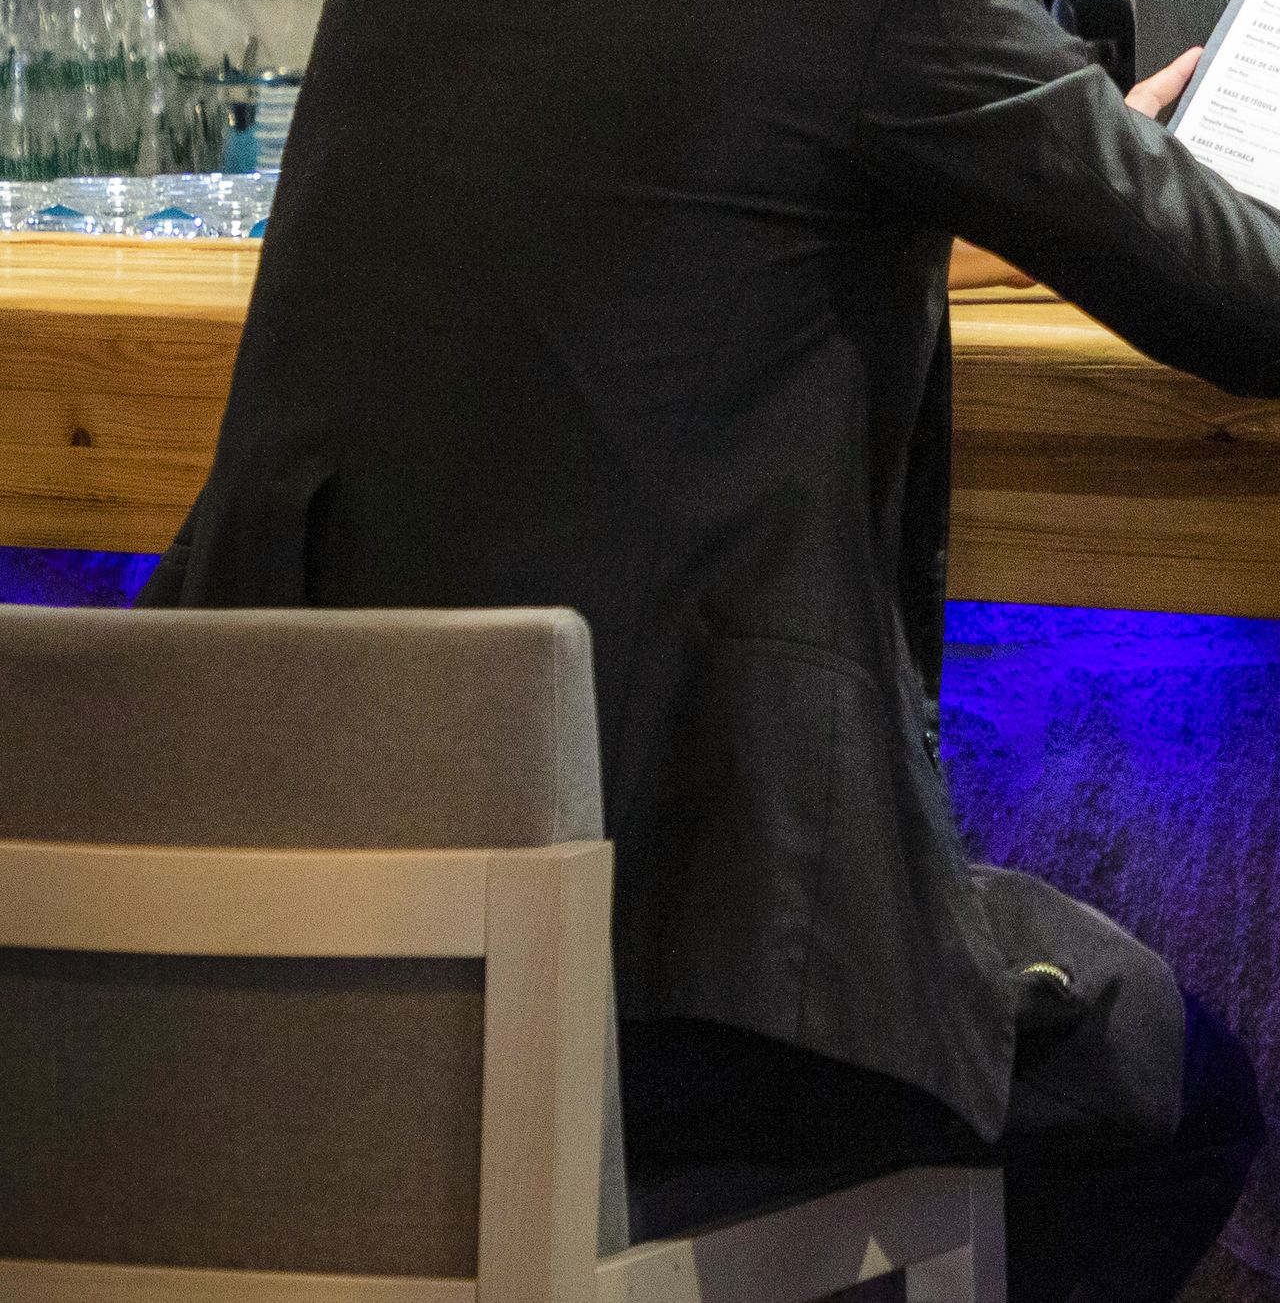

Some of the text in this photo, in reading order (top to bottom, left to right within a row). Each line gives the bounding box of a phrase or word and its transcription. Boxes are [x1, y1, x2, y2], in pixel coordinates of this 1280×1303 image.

[1258, 61, 1267, 69] DE
[1267, 64, 1280, 73] GIN
[1222, 87, 1240, 99] BASE
[1240, 94, 1250, 103] DE
[1197, 138, 1214, 148] BASE
[1214, 143, 1224, 152] DE
